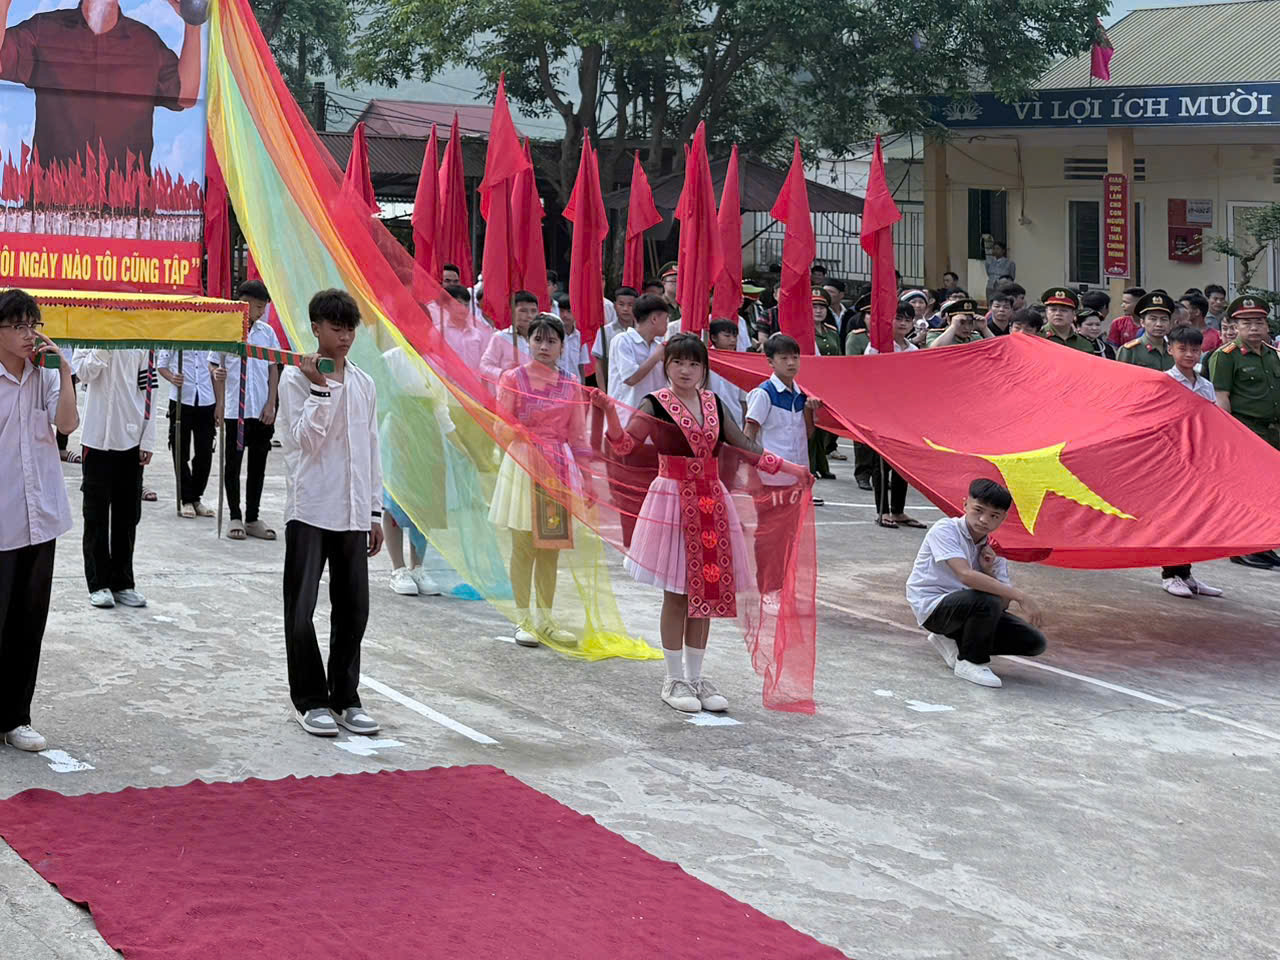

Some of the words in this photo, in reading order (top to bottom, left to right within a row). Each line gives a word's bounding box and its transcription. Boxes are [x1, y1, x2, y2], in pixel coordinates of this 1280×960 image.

[1012, 95, 1043, 120] VÌ
[1050, 96, 1103, 124] LỢI
[1111, 92, 1169, 118] ÍCH
[1178, 88, 1272, 117] MƯỜI
[19, 246, 59, 279] NGÀY
[61, 248, 92, 280] NÀO
[95, 250, 117, 282] TÔI
[121, 251, 159, 284] CŨNG
